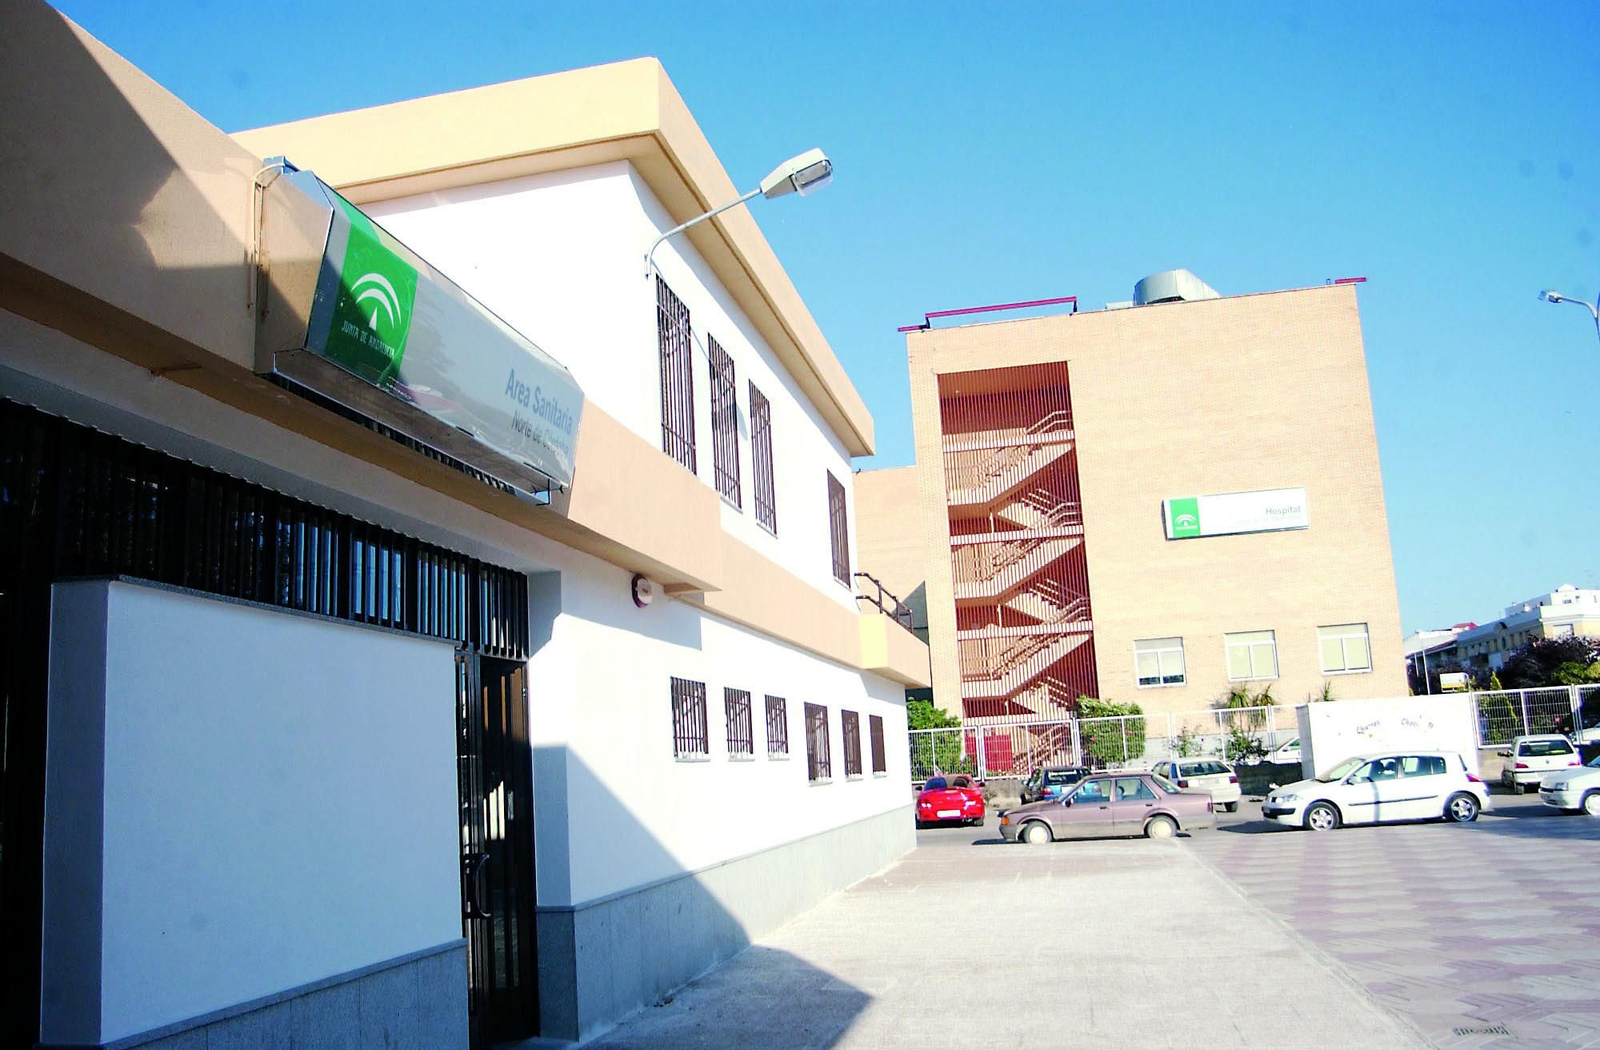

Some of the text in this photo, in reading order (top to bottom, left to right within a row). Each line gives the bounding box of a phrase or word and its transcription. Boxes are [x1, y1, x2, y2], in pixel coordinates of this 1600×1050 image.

[341, 320, 359, 339] JUNTA
[360, 330, 368, 344] DE
[505, 368, 573, 435] Area Sanitaria
[511, 409, 533, 438] Norte
[532, 424, 544, 445] de
[1265, 505, 1301, 516] Hospital
